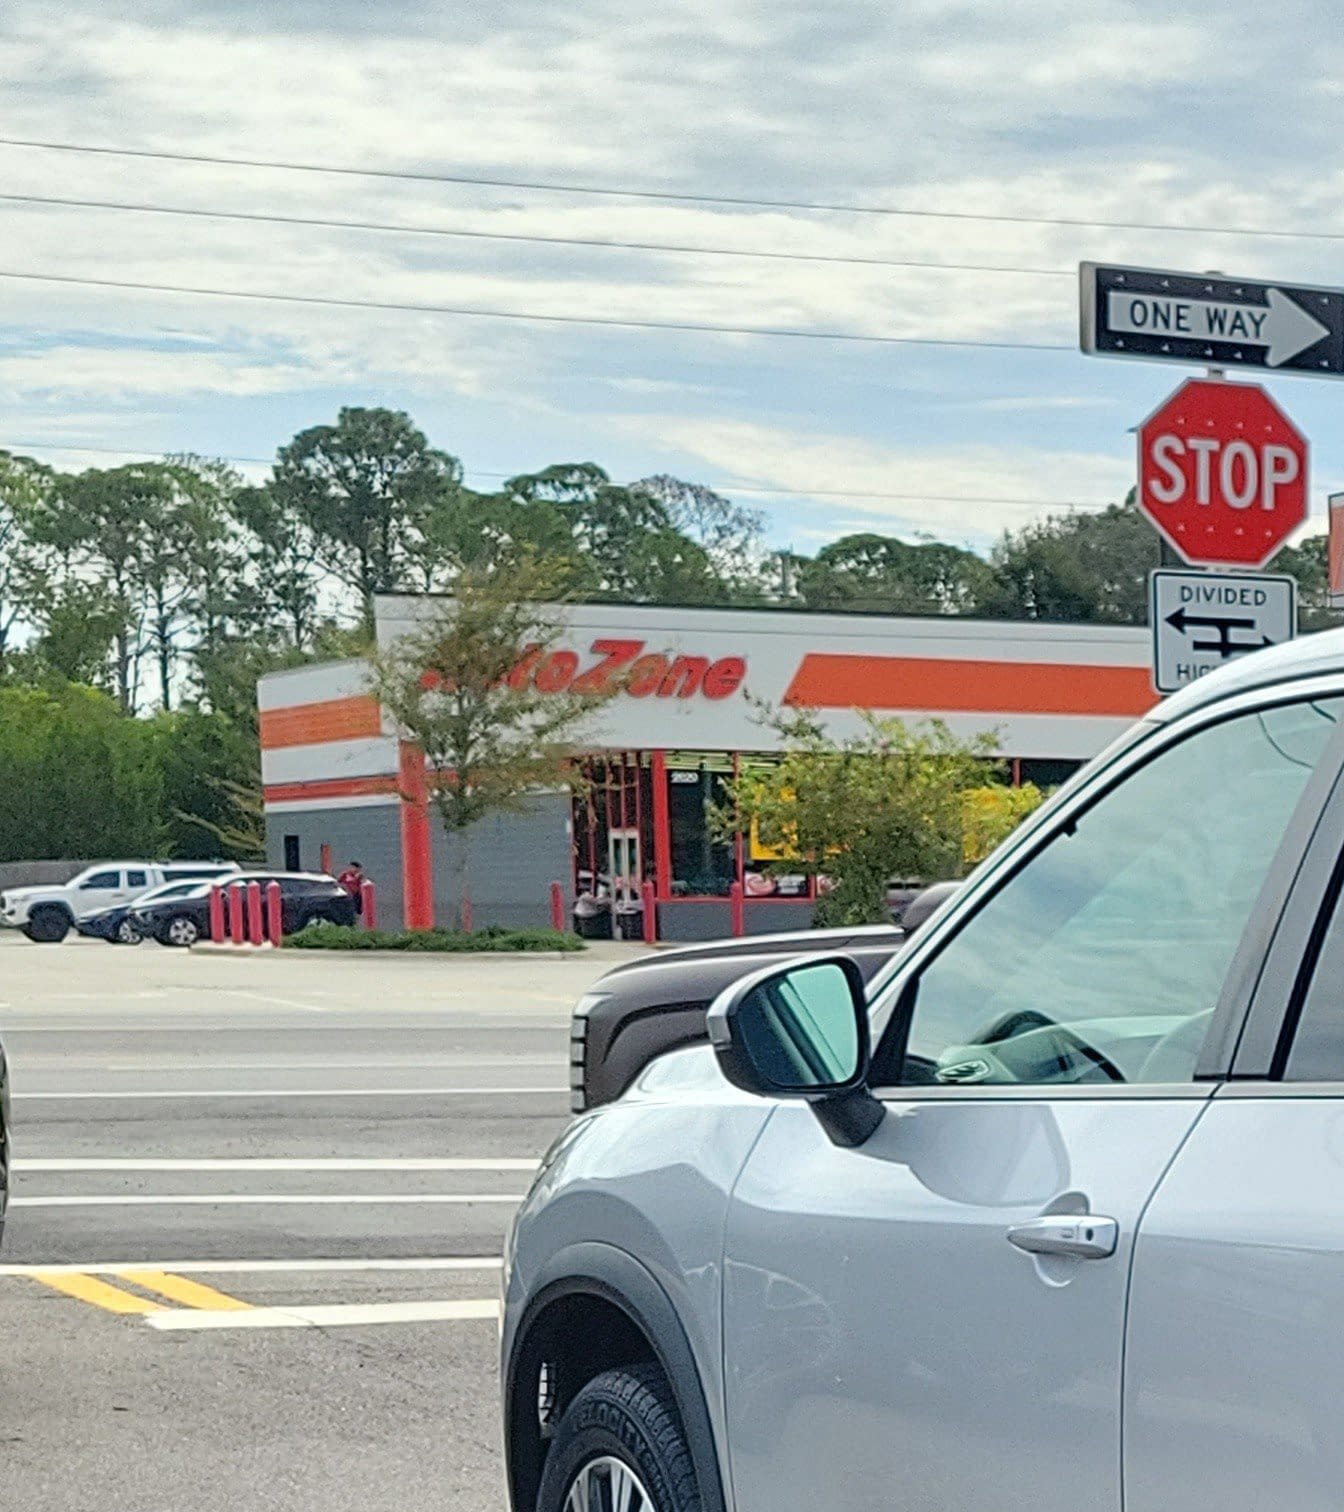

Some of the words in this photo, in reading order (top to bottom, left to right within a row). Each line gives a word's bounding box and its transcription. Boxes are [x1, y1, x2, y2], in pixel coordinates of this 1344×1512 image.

[1130, 299, 1191, 332] ONE
[1206, 307, 1267, 339] WAY
[1148, 435, 1298, 510] STOP
[1180, 585, 1267, 606] DIVIDED
